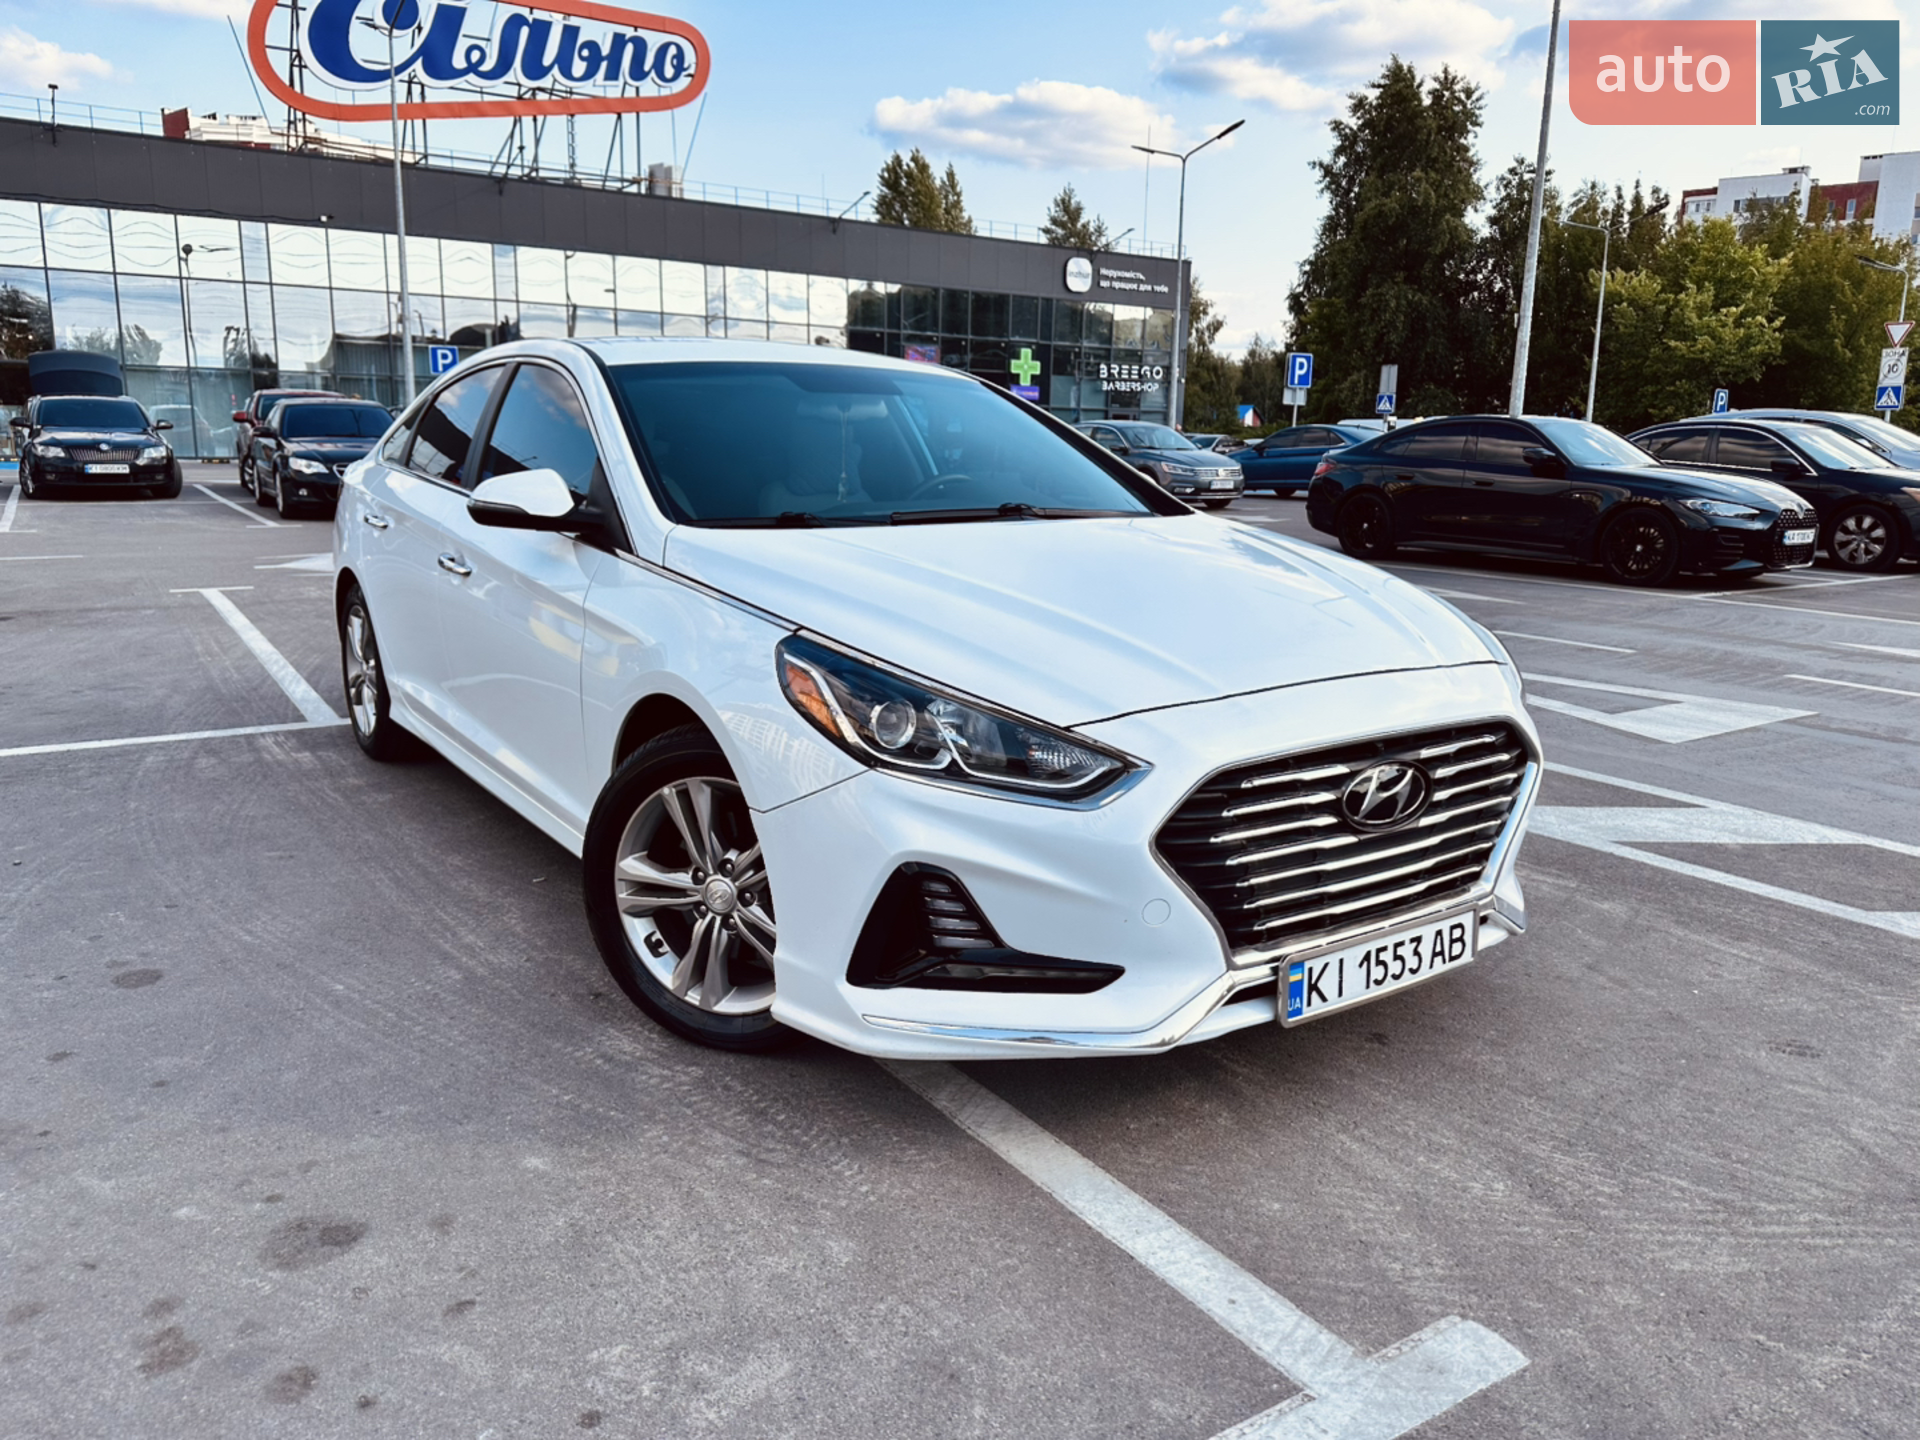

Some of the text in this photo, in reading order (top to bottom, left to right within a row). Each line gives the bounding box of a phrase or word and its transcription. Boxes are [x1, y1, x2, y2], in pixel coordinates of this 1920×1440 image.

[1100, 364, 1163, 379] BREEGO
[1102, 380, 1160, 392] BARBERSHOP
[1306, 922, 1467, 1008] KI 1553 AB
[1287, 997, 1302, 1012] UA
